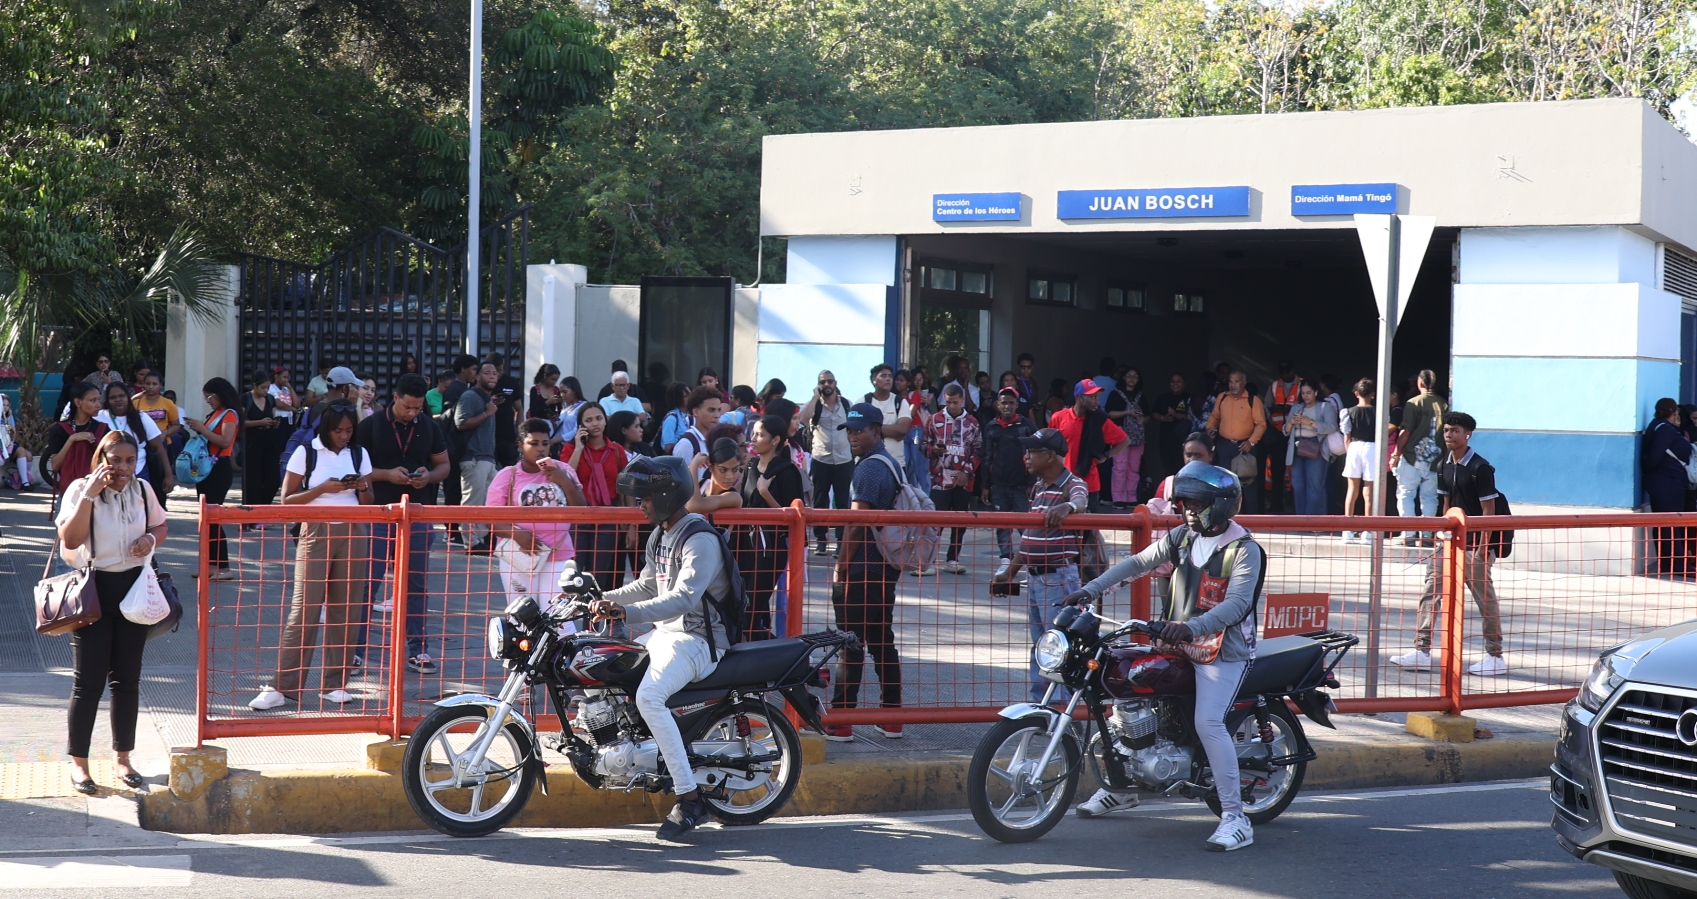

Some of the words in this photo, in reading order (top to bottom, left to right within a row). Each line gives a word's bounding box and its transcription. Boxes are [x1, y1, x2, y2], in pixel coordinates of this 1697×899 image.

[937, 199, 970, 207] Dirección
[1088, 196, 1139, 211] JUAN
[1145, 194, 1214, 210] BOSCH
[1294, 195, 1334, 203] Dirección
[1336, 193, 1363, 202] Mamá
[1365, 193, 1392, 203] Tingó
[963, 207, 974, 215] de
[988, 206, 1016, 214] Héroes
[1267, 605, 1325, 629] MOPC
